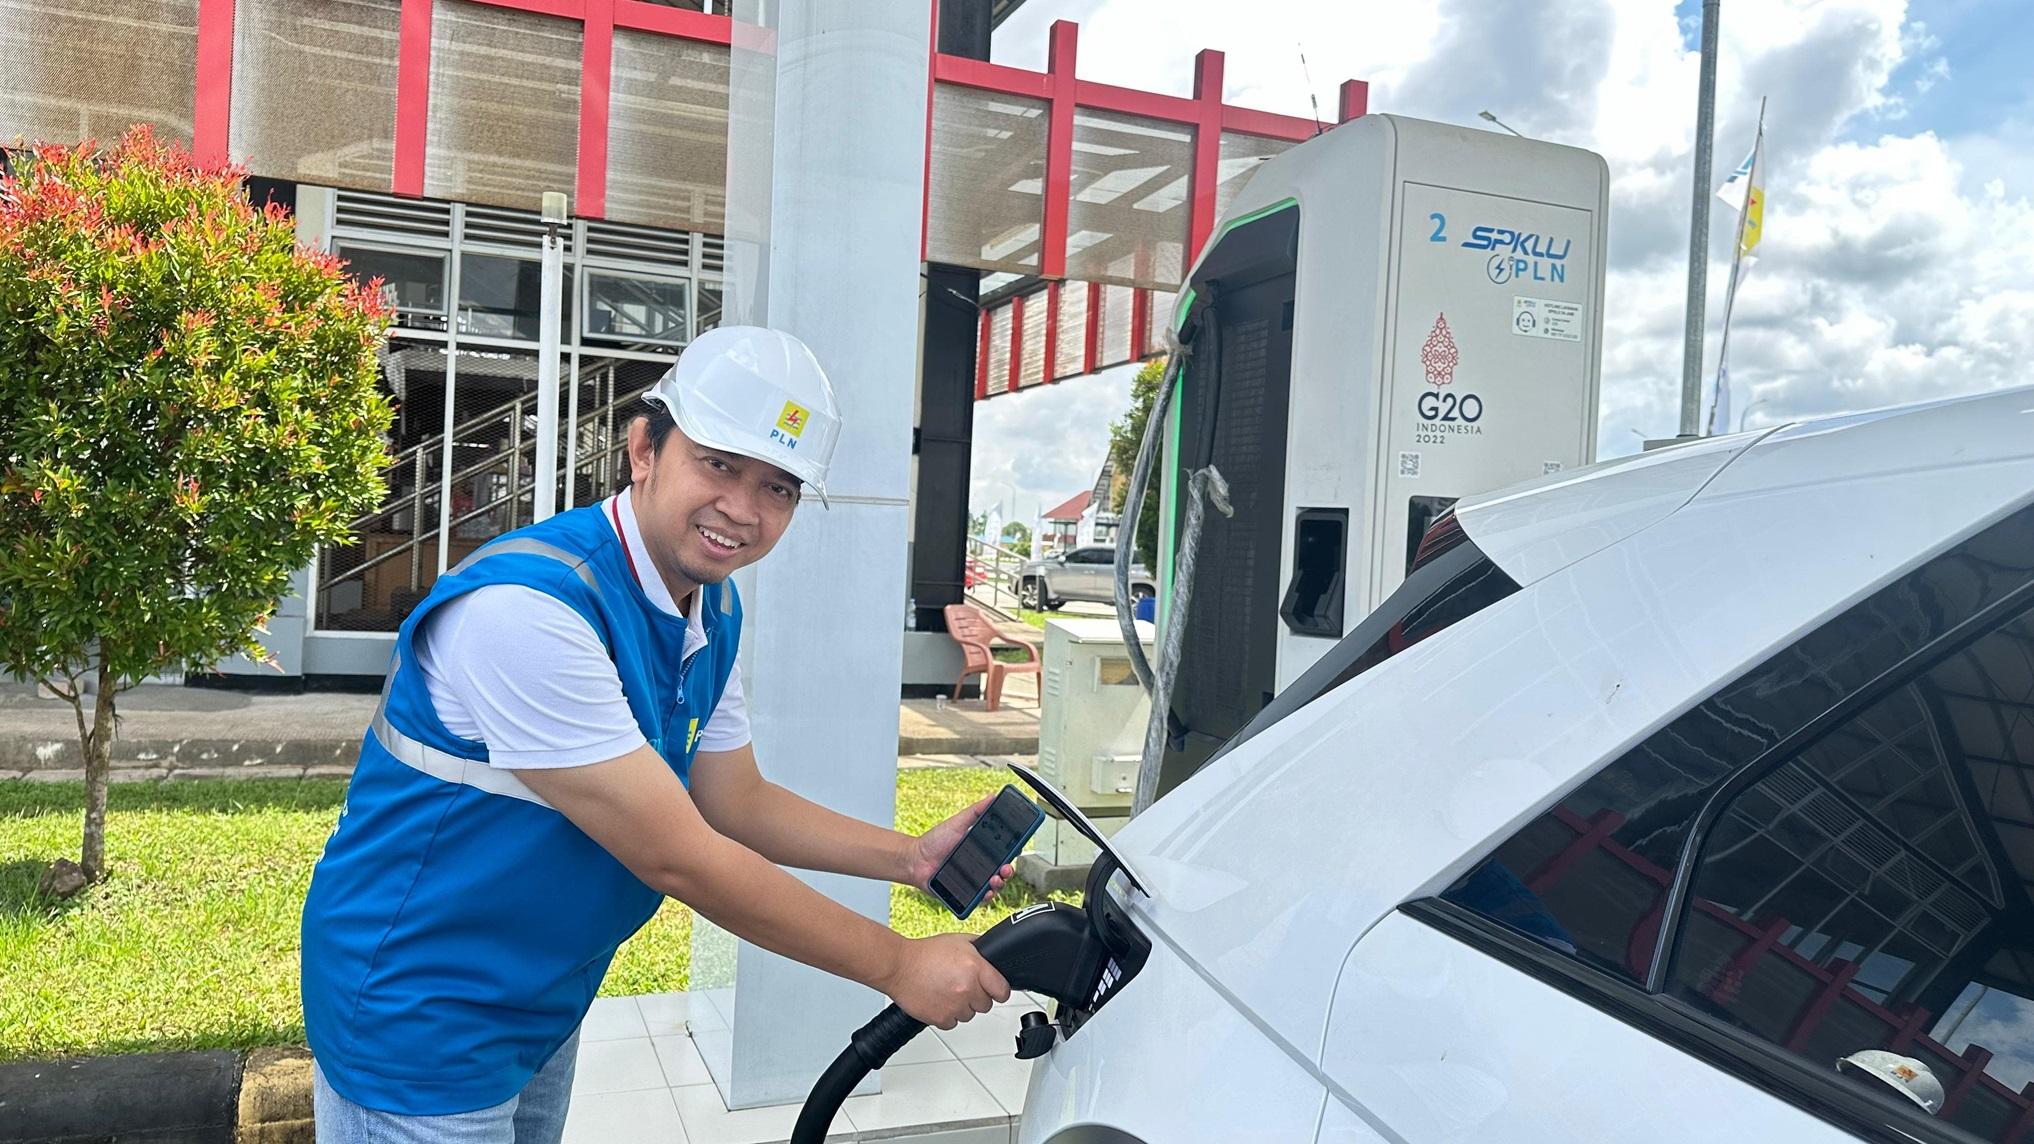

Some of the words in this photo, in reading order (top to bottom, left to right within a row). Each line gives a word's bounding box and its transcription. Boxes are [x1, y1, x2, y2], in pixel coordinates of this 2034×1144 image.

[1430, 212, 1447, 242] 2
[1460, 225, 1571, 260] SPKLU
[1514, 258, 1565, 283] PLN
[1417, 391, 1483, 423] G20
[769, 429, 797, 450] PLN
[1416, 422, 1482, 435] INDONESIA
[1416, 434, 1446, 444] 2022
